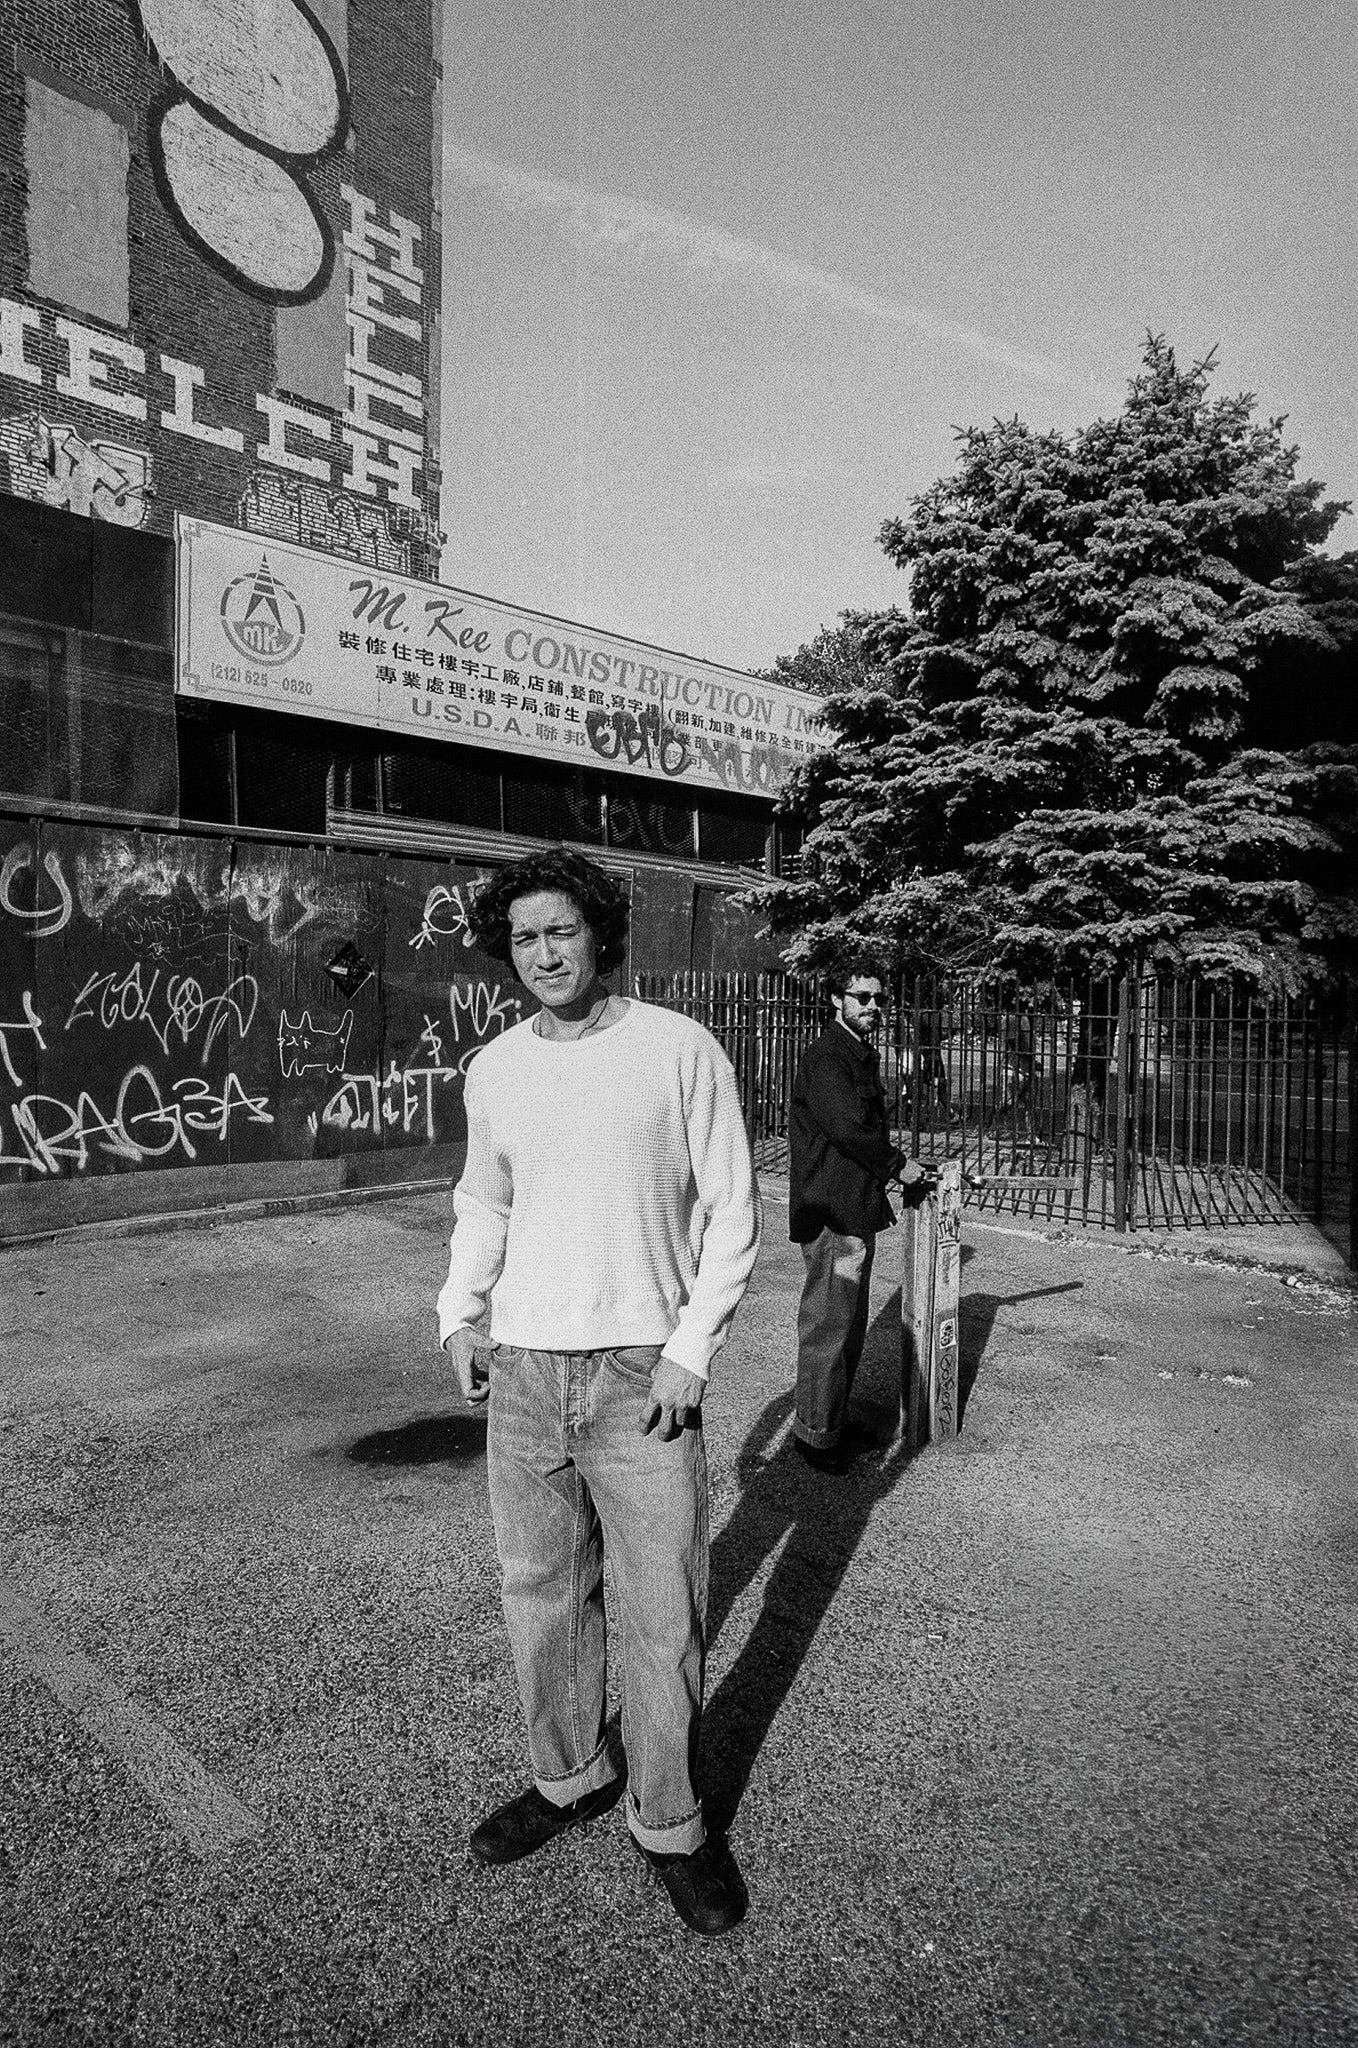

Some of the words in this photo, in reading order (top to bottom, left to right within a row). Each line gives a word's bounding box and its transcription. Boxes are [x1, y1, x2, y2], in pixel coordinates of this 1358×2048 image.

[348, 579, 410, 633] M.
[424, 600, 491, 653] Kee
[503, 628, 776, 725] CONSTRUCTION
[411, 696, 531, 738] U.S.D.A.
